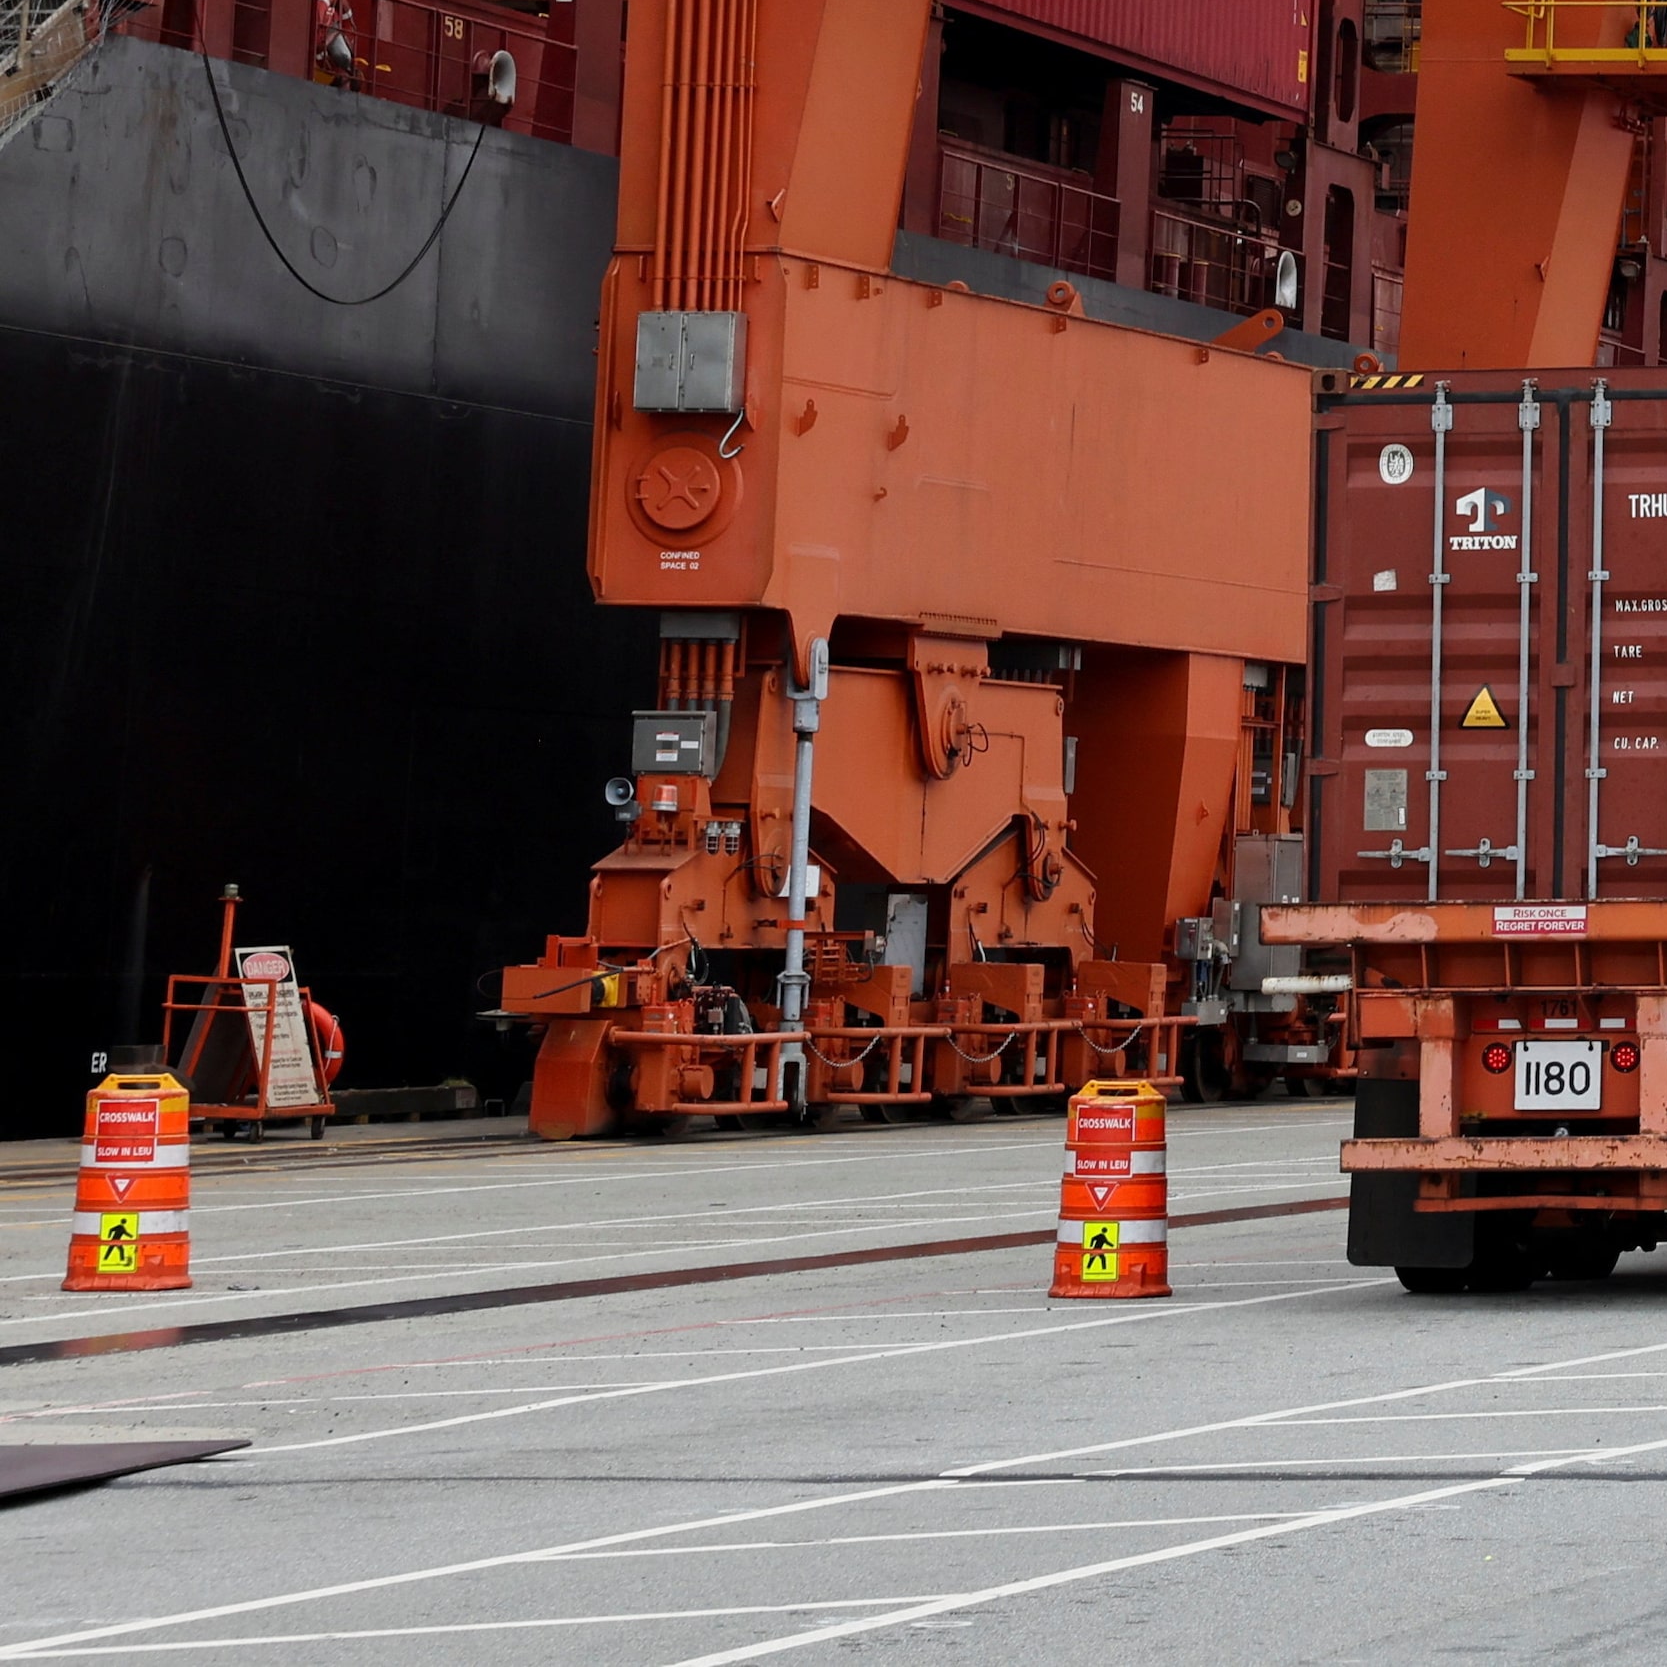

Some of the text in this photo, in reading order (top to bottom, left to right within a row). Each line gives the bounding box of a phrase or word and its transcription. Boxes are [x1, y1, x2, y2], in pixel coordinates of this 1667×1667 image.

[1130, 92, 1144, 114] 54
[1450, 535, 1517, 550] TRITON
[660, 552, 700, 560] CONFINED
[660, 562, 686, 570] SPACE
[1614, 646, 1642, 658] TARE
[1613, 691, 1633, 704] NET
[1513, 908, 1567, 918] RISK ONCE
[1496, 920, 1585, 932] REGRET FOREVER
[247, 961, 286, 976] DANGER
[1540, 999, 1579, 1017] 1761
[1525, 1061, 1591, 1096] 1180
[100, 1111, 154, 1123] CROSSWALK
[1079, 1118, 1131, 1129] CROSSWALK
[97, 1147, 152, 1157] SLOW IN LEIU
[1077, 1160, 1128, 1169] SLOW IN LEIU
